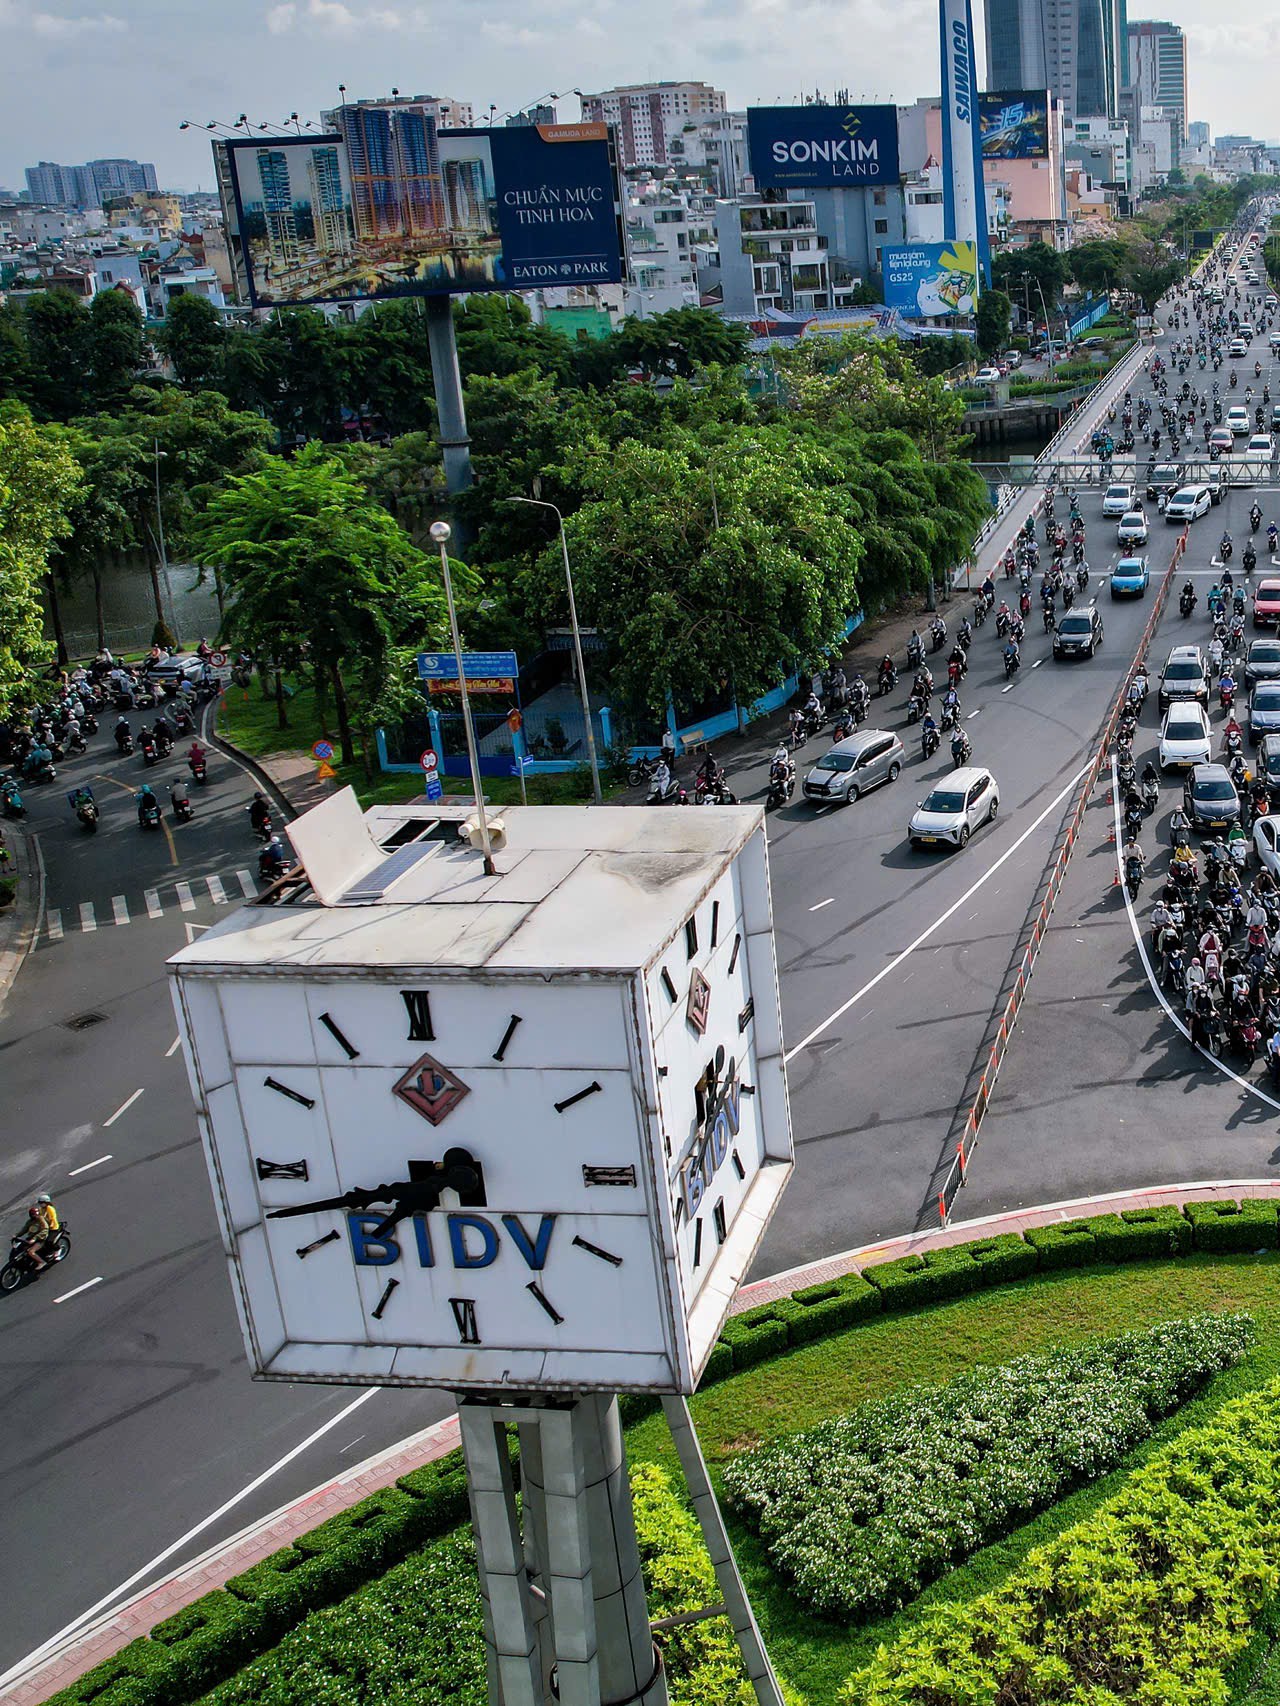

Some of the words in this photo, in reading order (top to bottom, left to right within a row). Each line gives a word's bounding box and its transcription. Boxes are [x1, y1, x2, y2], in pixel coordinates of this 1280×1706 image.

[953, 20, 971, 125] SAWACO
[772, 139, 878, 163] SONKIM
[832, 163, 880, 176] LAND
[504, 185, 560, 206] CHUẨN
[565, 186, 603, 205] MỰC
[516, 208, 554, 224] TINH
[559, 207, 594, 222] HOA
[513, 264, 558, 278] EATON
[574, 261, 609, 273] PARK
[889, 273, 914, 282] GS25
[347, 1209, 558, 1270] BIDV
